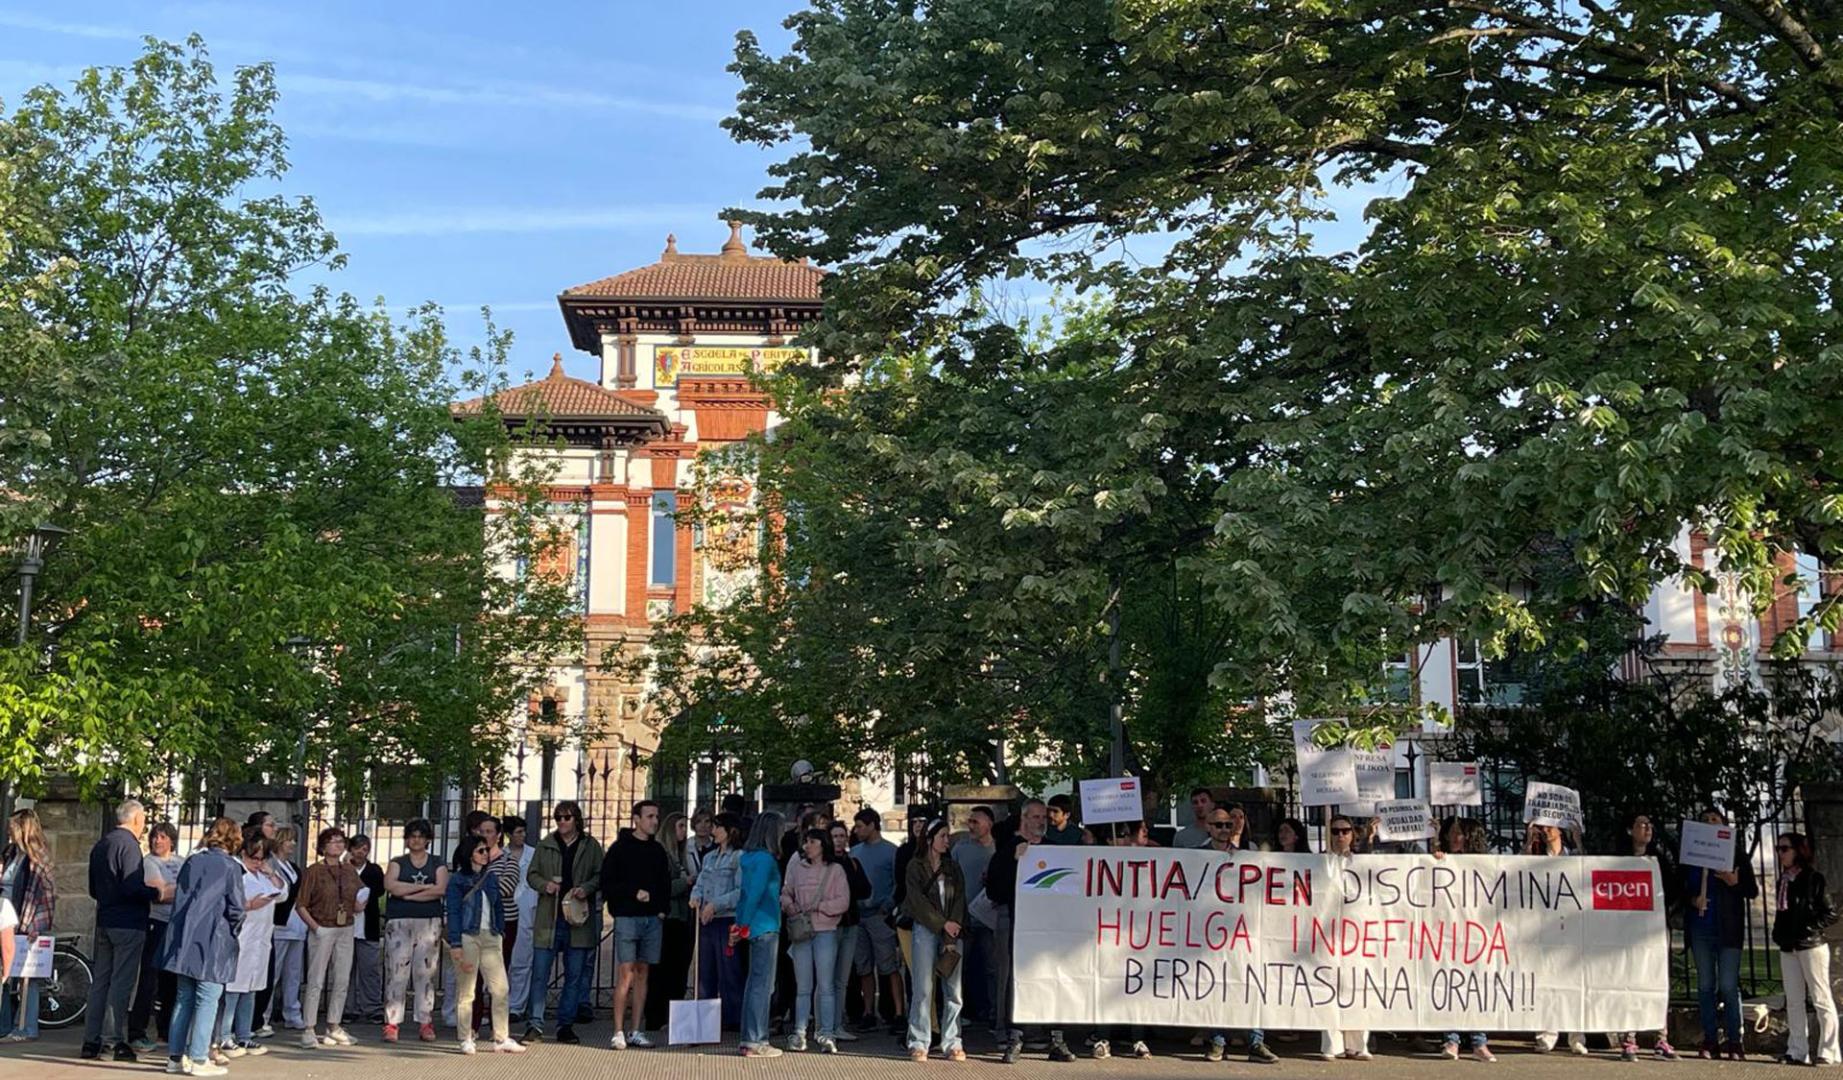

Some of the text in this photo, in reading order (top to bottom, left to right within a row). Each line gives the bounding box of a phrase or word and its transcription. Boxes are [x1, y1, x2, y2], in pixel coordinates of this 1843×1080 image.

[1085, 857, 1582, 911] INTIA/CPEN DISCRIMINA
[1595, 880, 1650, 901] cpen
[1096, 908, 1510, 965] HUELGA INDEFINIDA
[1430, 968, 1536, 1013] ORAIN!!
